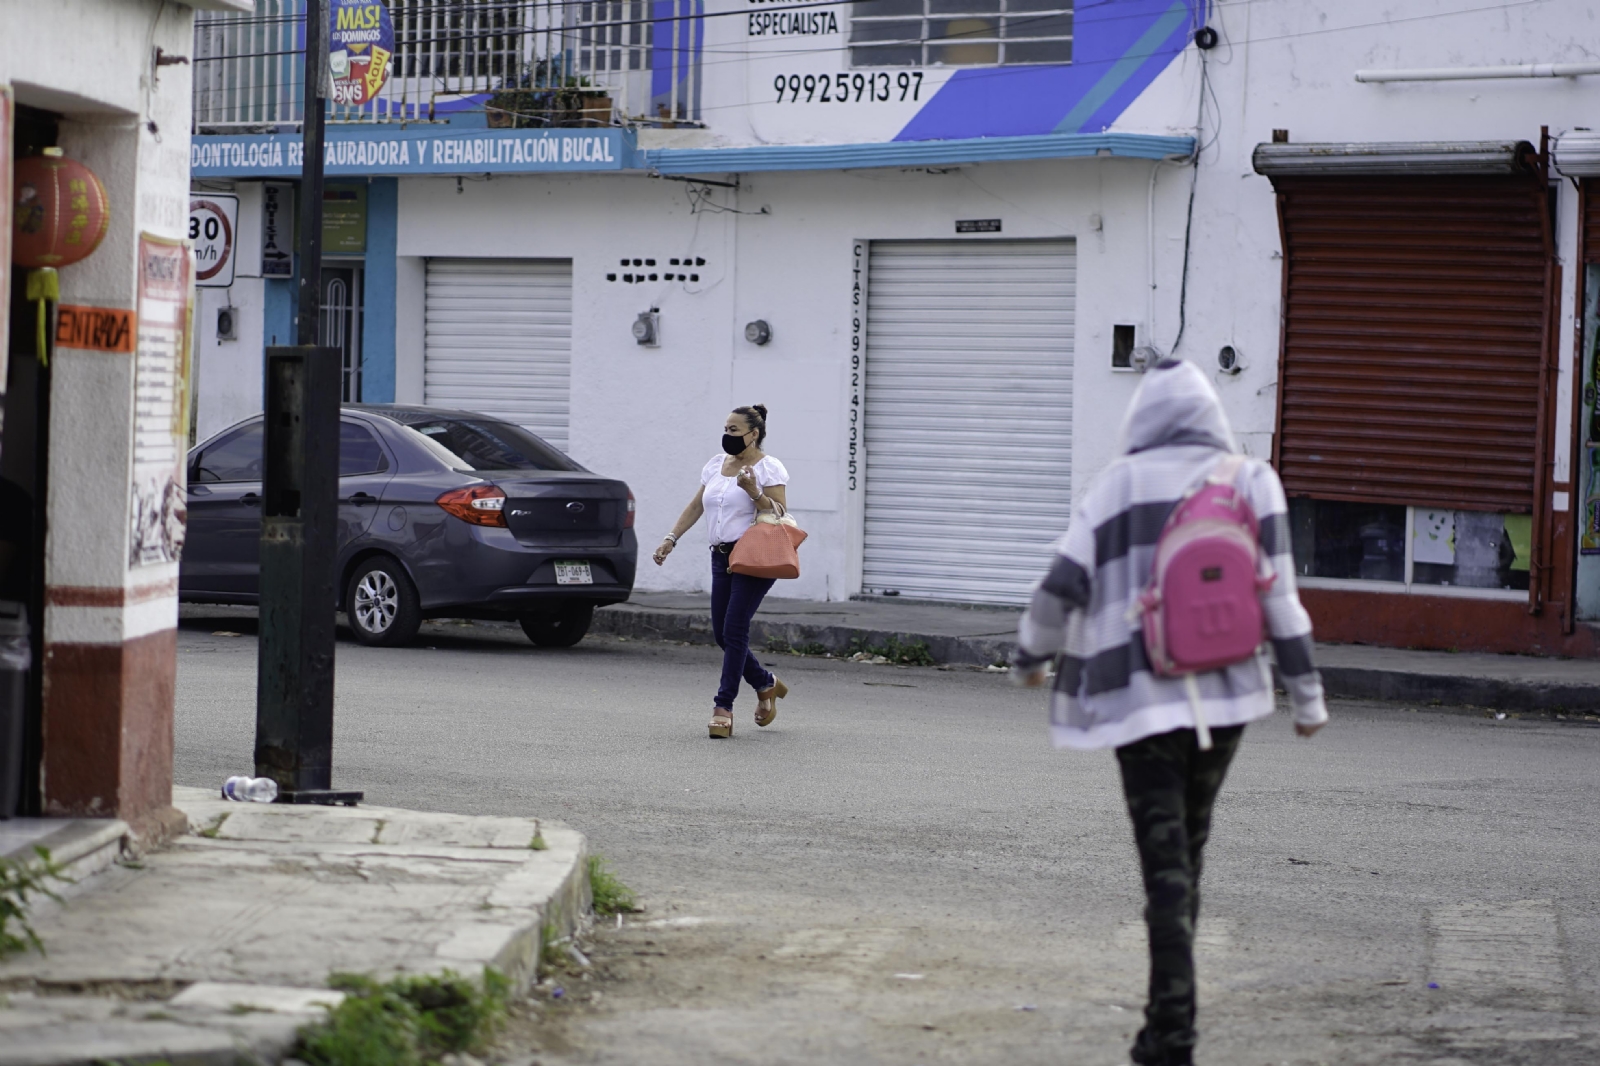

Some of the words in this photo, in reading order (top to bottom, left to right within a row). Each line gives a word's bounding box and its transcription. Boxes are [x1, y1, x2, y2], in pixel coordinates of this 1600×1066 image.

[337, 5, 381, 30] MÁS!
[749, 11, 839, 36] ESPECIALISTA
[341, 30, 381, 42] DOMINGOS
[288, 140, 410, 167] REAURADORA
[416, 140, 428, 165] Y
[433, 131, 559, 164] REHABILITACIÓN
[562, 137, 614, 163] BUCAL
[190, 216, 219, 240] 30
[56, 309, 131, 350] ENTRADA
